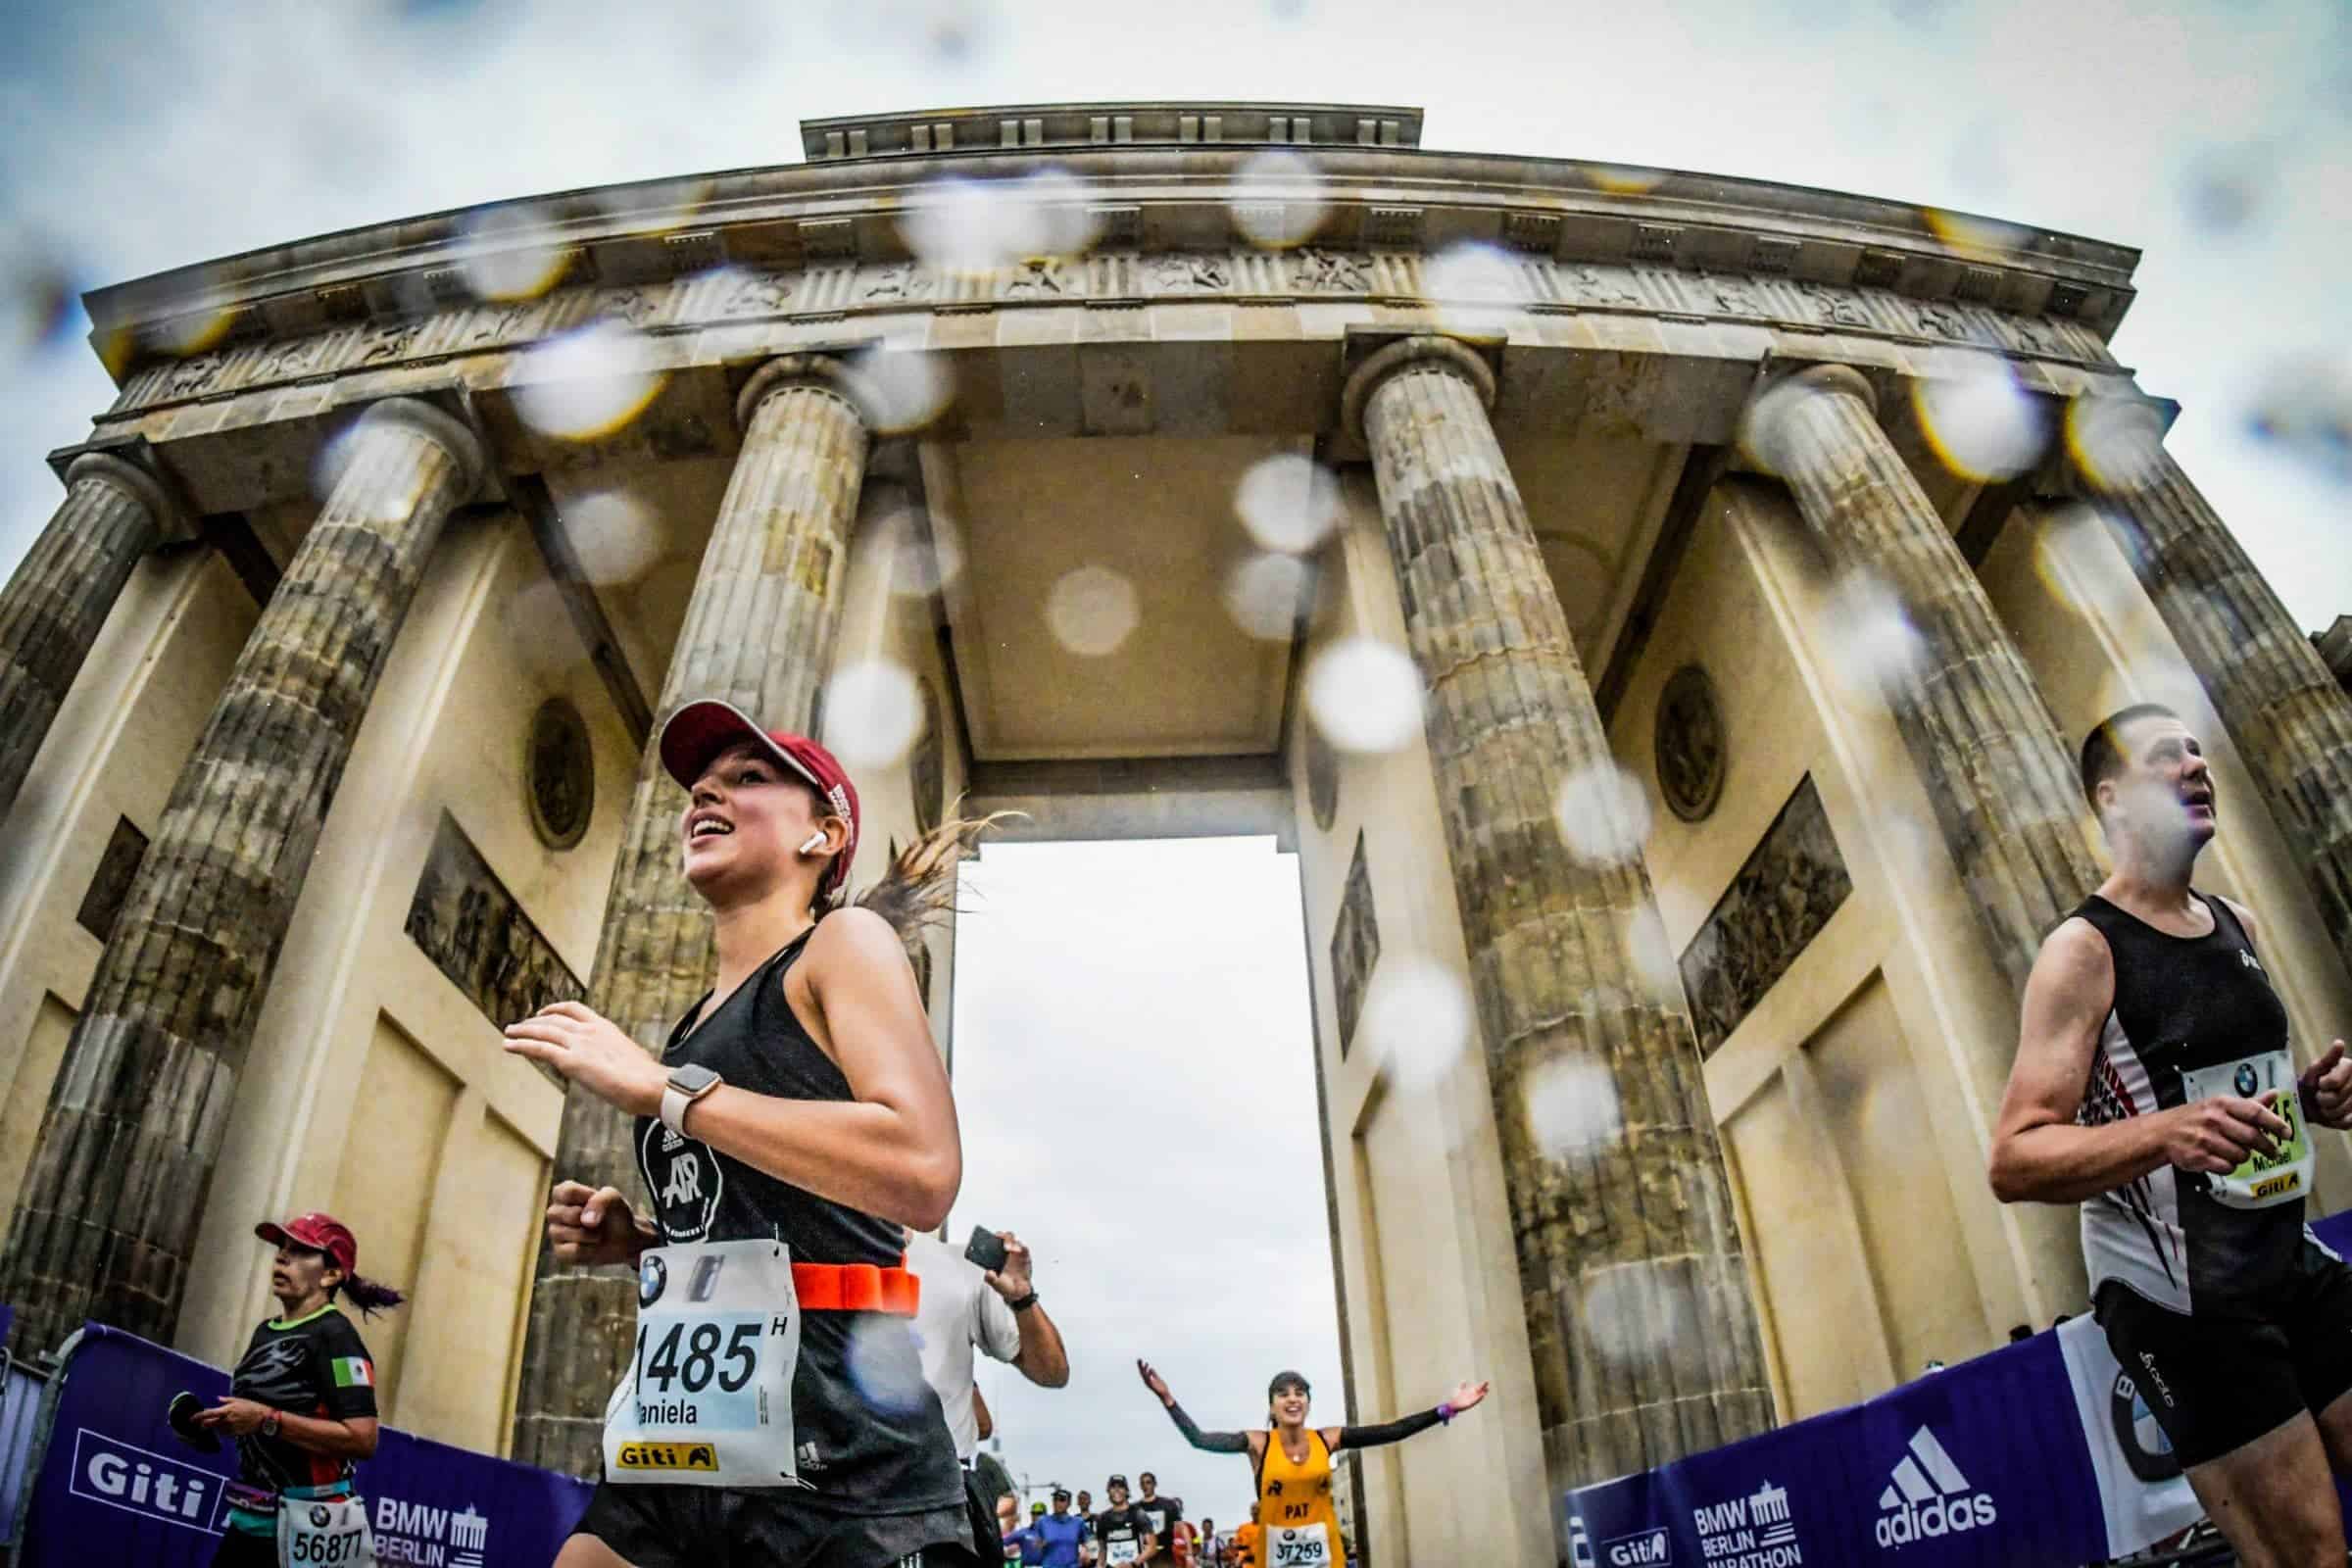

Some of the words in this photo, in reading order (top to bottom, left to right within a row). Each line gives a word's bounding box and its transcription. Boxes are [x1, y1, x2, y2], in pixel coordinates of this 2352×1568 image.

[770, 1316, 788, 1336] H
[637, 1398, 698, 1425] aniela
[620, 1446, 678, 1466] Giti
[87, 1451, 205, 1519] Giti
[375, 1496, 449, 1541] BMW
[1285, 1502, 1310, 1520] PAT
[1693, 1497, 1747, 1537] BMW
[1875, 1493, 1997, 1547] adidas
[293, 1529, 363, 1563] 56877
[373, 1534, 446, 1568] BERLIN
[1701, 1529, 1757, 1558] BERLIN
